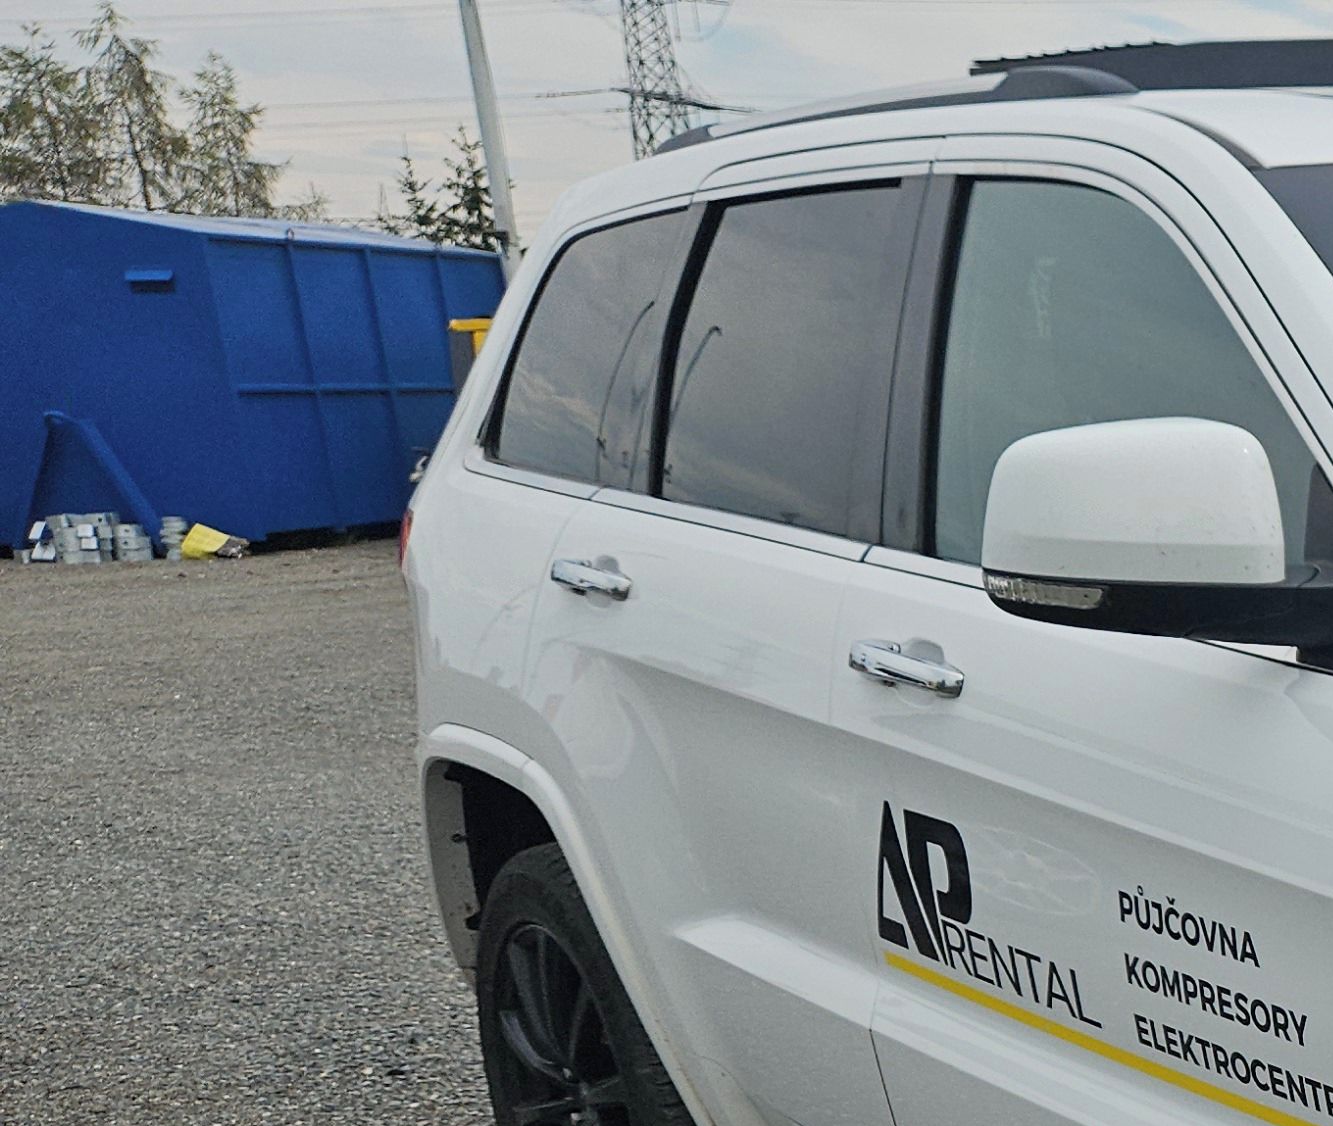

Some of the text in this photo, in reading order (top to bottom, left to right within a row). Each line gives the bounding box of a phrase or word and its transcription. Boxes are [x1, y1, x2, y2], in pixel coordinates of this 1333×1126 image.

[878, 800, 972, 967] AP
[1118, 885, 1260, 968] PŮJČOVNA
[941, 919, 1103, 1029] RENTAL
[1124, 953, 1307, 1047] KOMPRESORY
